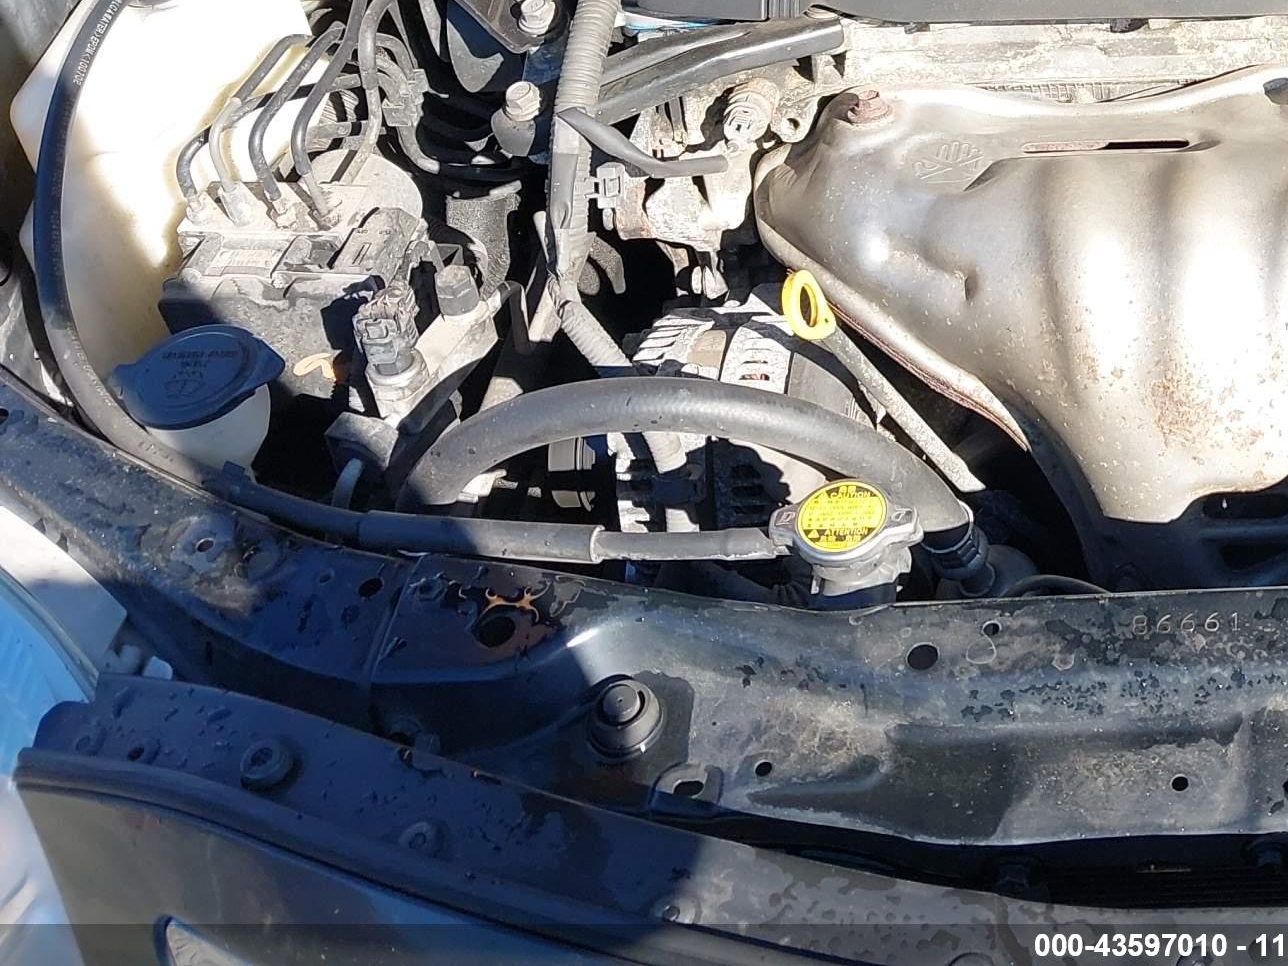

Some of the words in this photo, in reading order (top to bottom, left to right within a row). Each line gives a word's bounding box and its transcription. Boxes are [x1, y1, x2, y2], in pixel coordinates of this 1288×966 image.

[830, 491, 872, 499] CAUTION
[824, 528, 869, 537] ATTENTION
[1132, 612, 1241, 635] 86661
